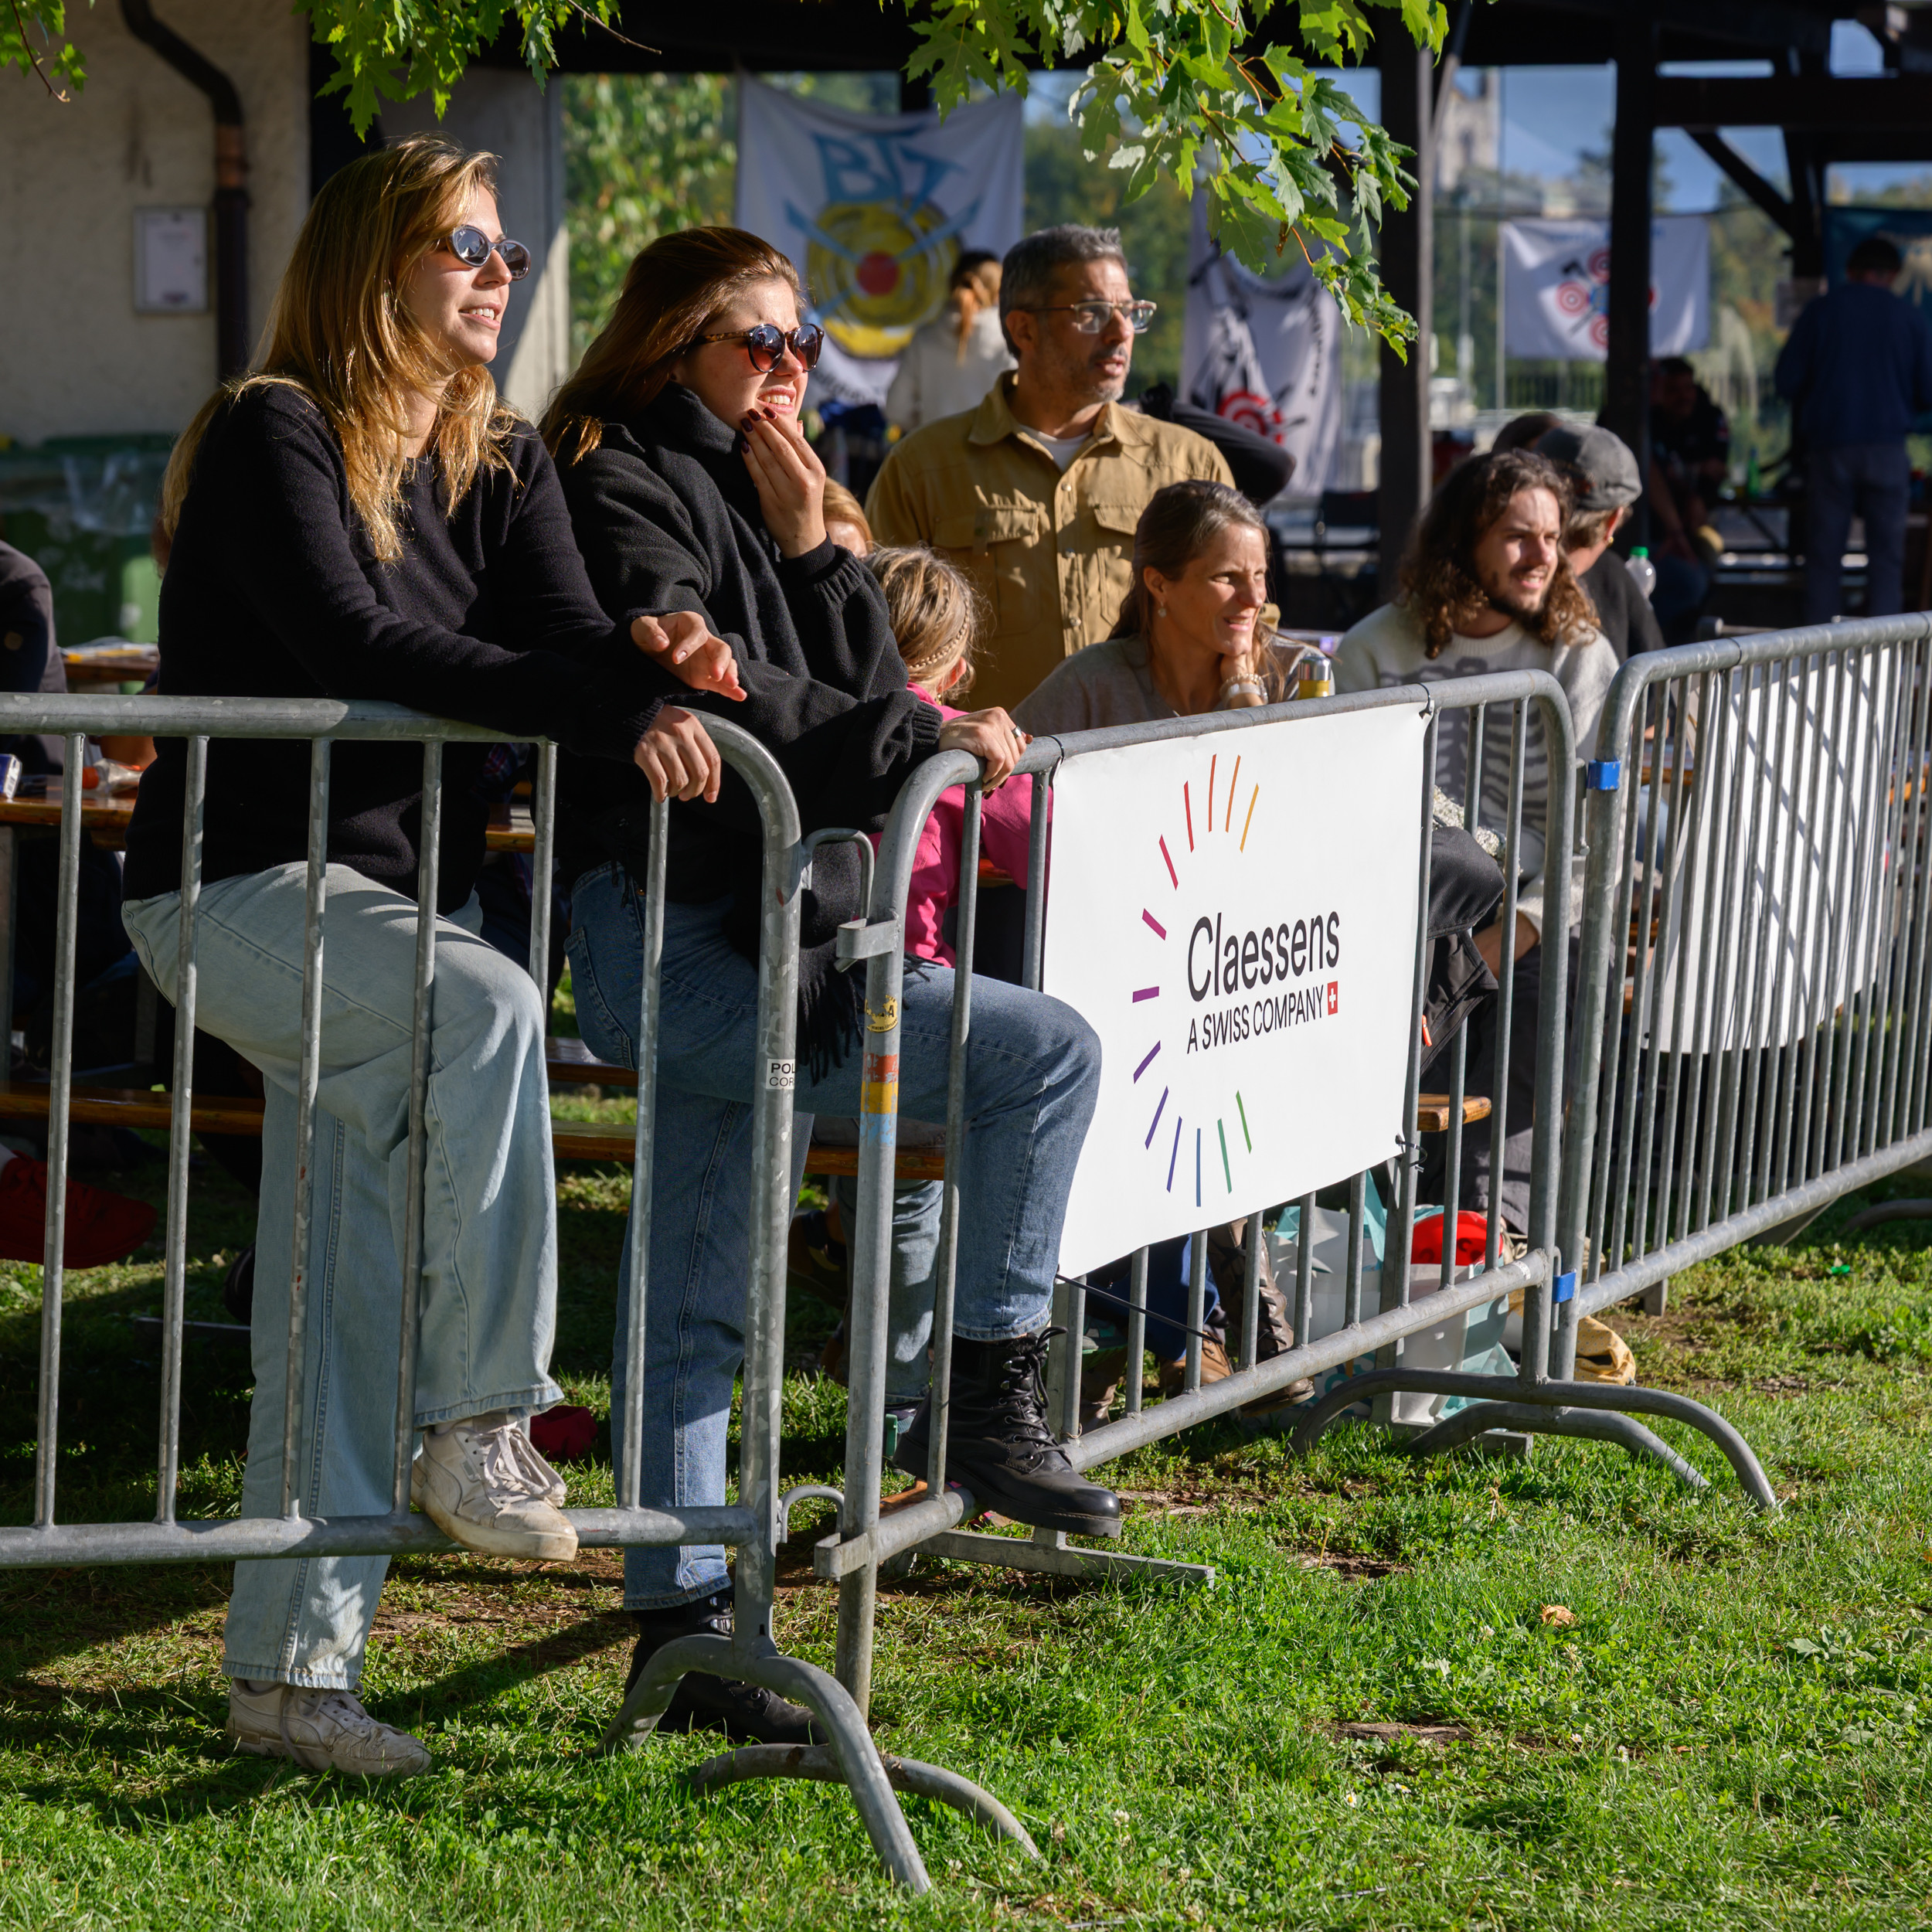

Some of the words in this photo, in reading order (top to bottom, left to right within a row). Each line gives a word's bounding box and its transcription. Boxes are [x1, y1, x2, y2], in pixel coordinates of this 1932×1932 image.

[1187, 911, 1340, 1002] Claessens
[1186, 1018, 1199, 1054] A
[1202, 1005, 1250, 1050] SWISS
[1253, 986, 1325, 1037] COMPANY
